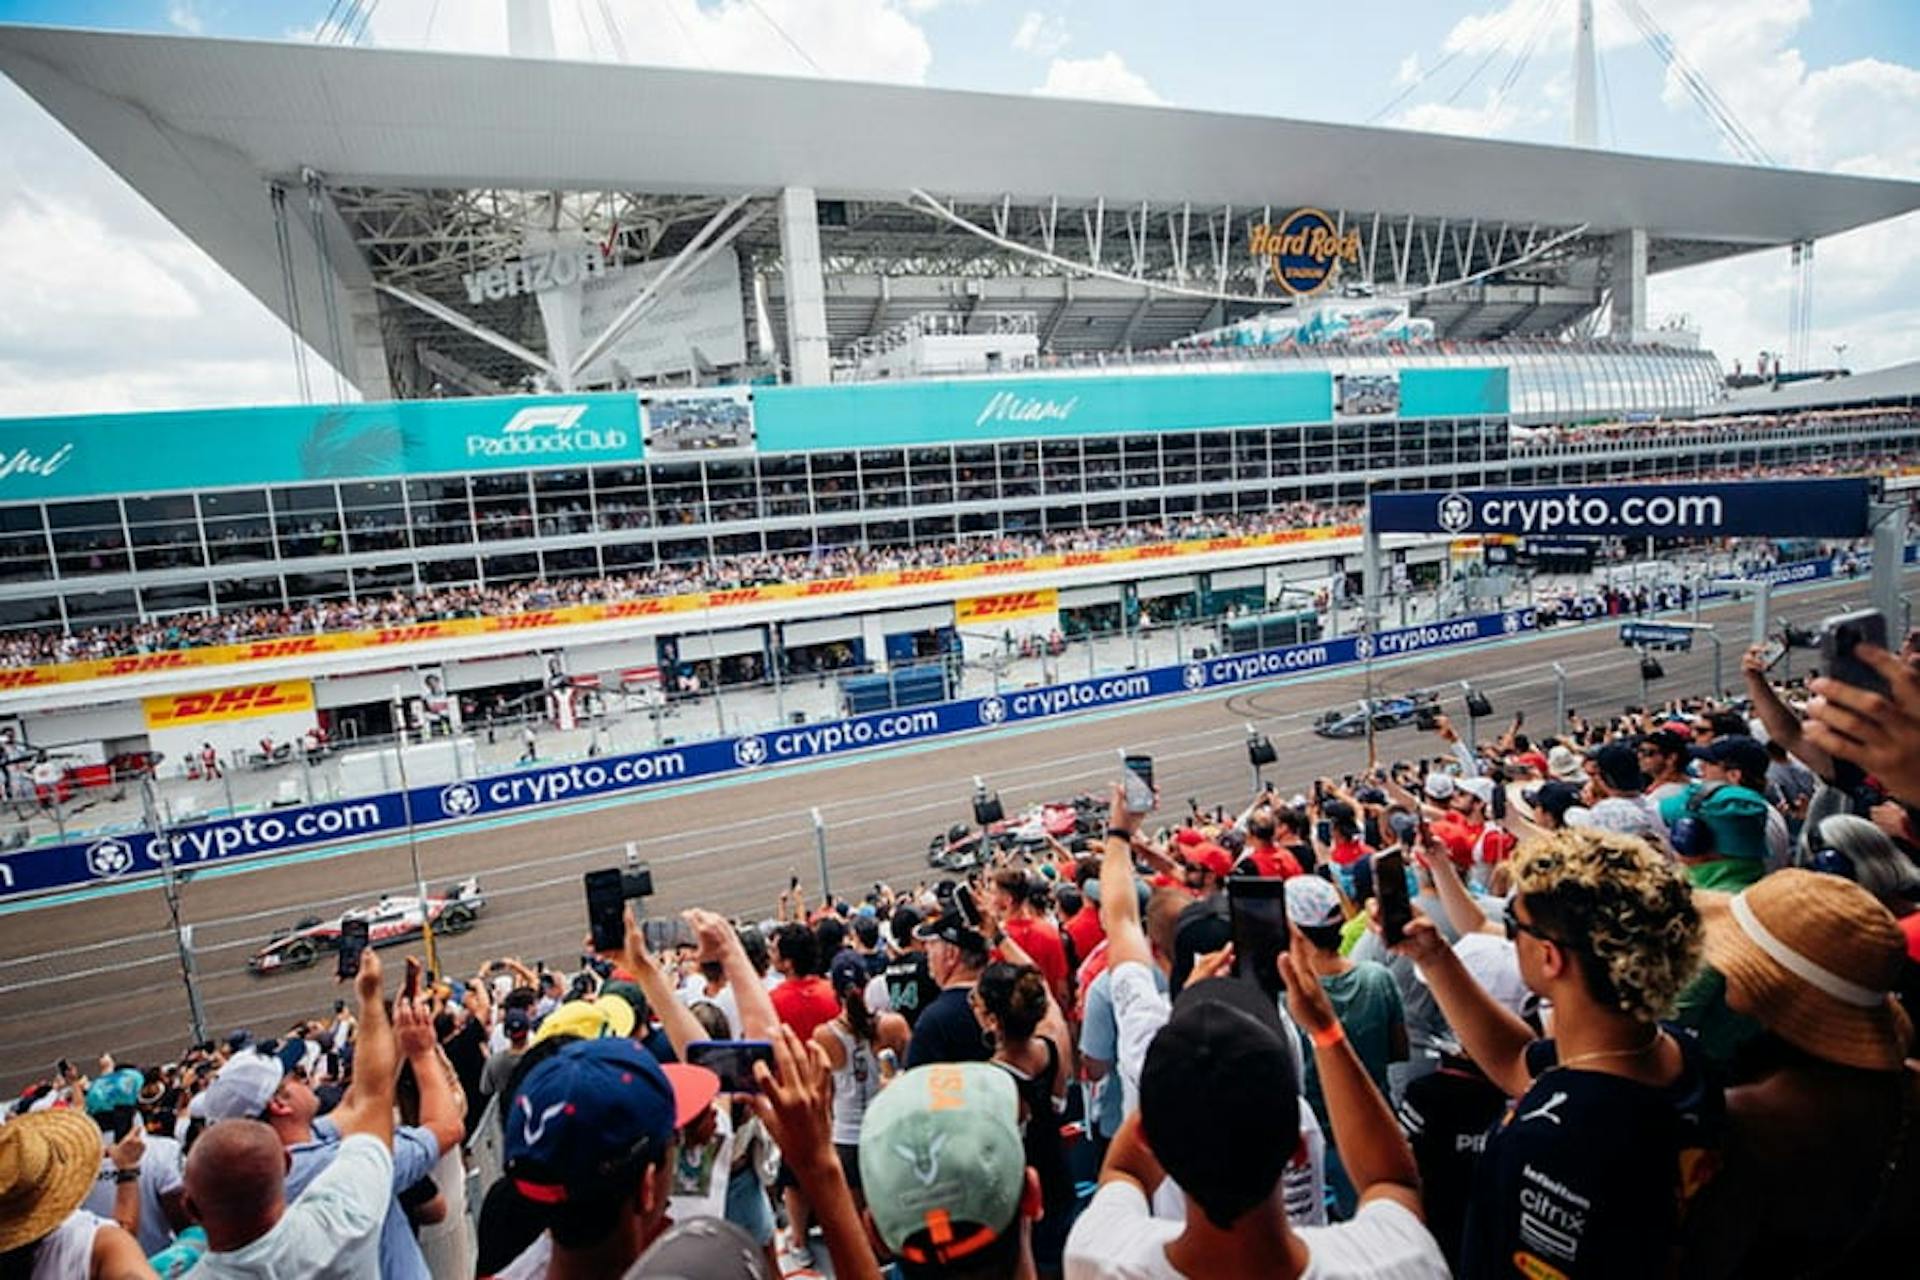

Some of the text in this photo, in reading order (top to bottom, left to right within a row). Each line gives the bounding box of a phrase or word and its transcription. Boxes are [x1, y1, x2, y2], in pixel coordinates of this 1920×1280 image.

[1250, 224, 1359, 263] Hard Rock
[976, 391, 1079, 427] Miami
[467, 427, 627, 457] Paddock Club
[1481, 494, 1723, 530] crypto.com
[709, 590, 761, 607] DHL
[808, 579, 856, 596] DHL
[974, 591, 1042, 616] DHL
[498, 611, 560, 632] DHL
[605, 600, 663, 619] DHL
[250, 638, 317, 659] DHL
[378, 624, 442, 644] DHL
[1379, 619, 1478, 652] crypto.com
[0, 669, 40, 688] HL
[112, 652, 187, 676] DHL
[1212, 644, 1328, 683] crypto.com
[173, 684, 286, 717] DHL
[1013, 675, 1150, 717] crypto.com
[775, 710, 938, 755] crypto.com
[491, 751, 684, 801] crypto.com
[146, 801, 381, 861] crypto.com
[1519, 1186, 1586, 1235] citrix
